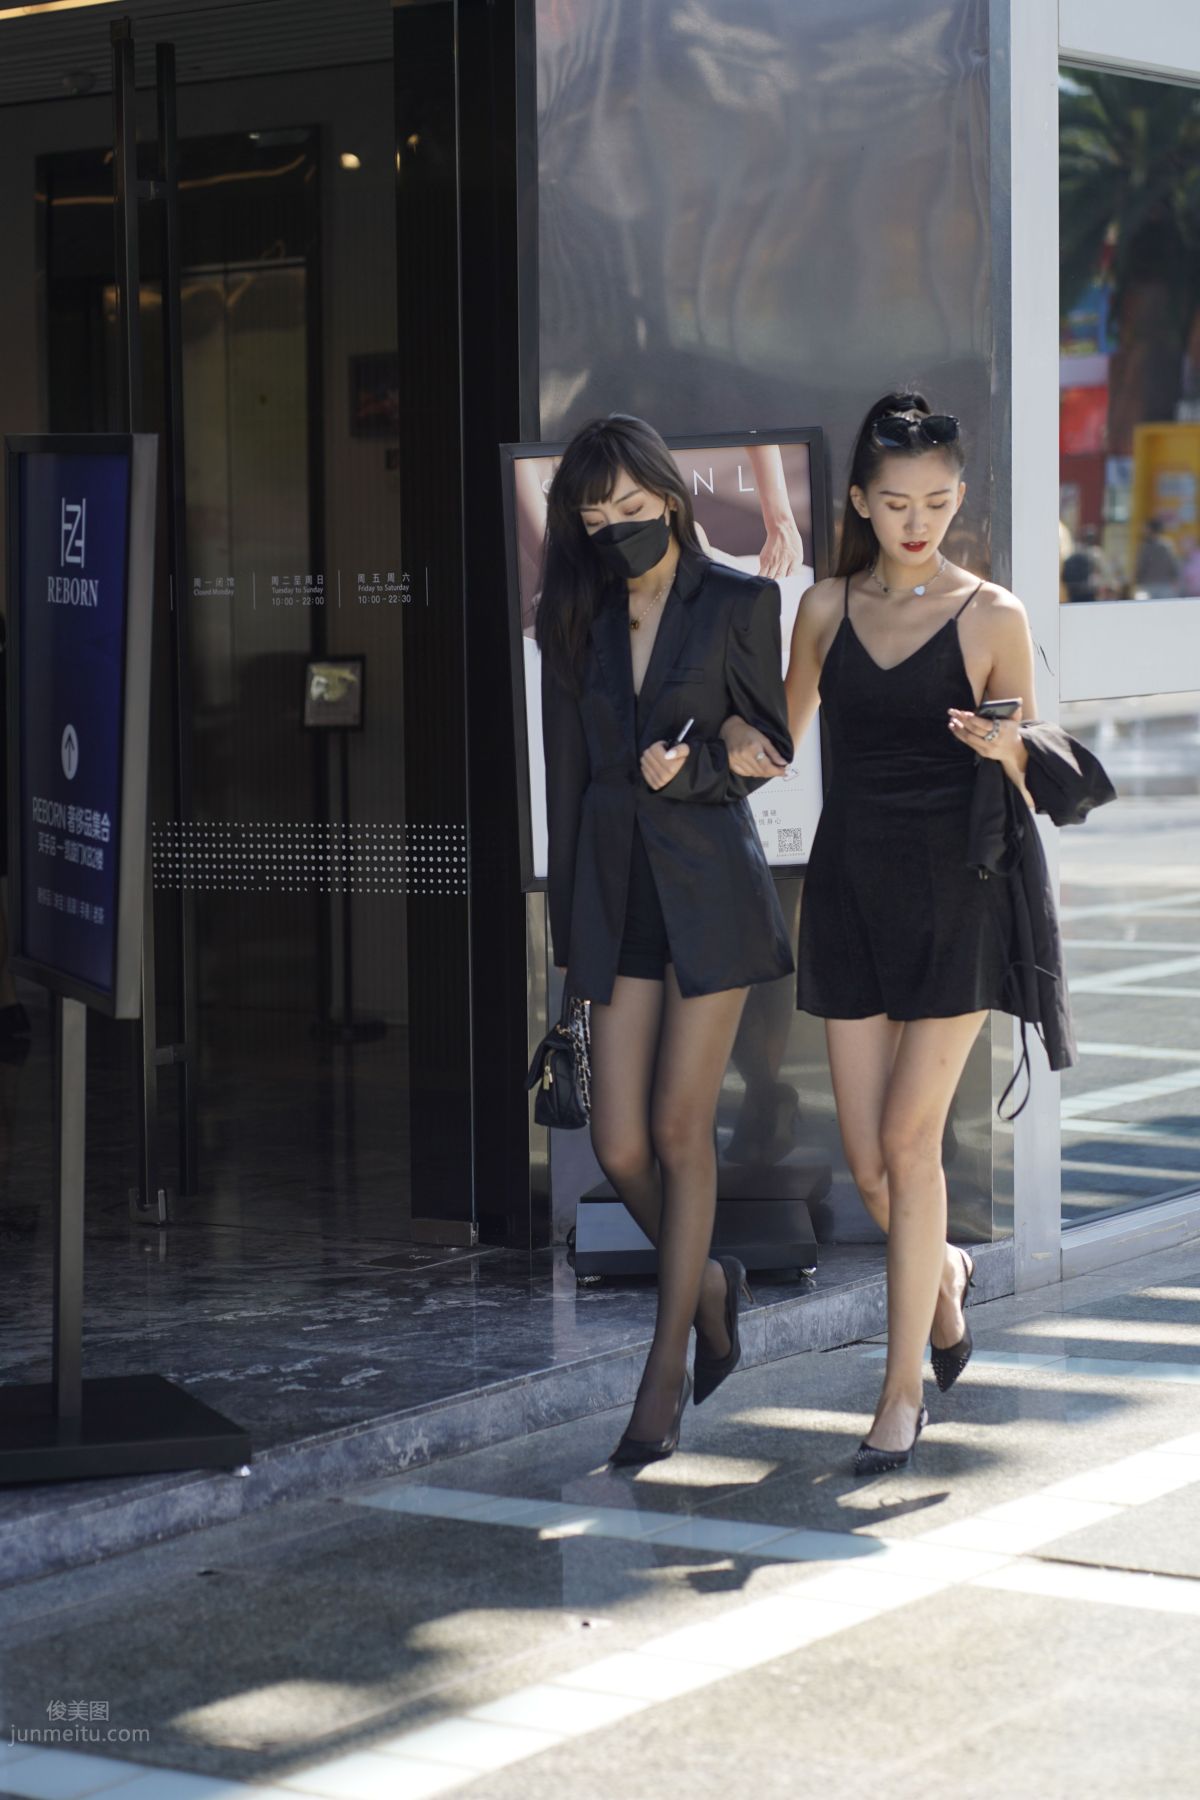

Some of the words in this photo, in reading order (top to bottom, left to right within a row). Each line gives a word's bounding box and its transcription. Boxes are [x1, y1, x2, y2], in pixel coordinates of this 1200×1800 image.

[47, 576, 99, 607] REBORN
[271, 597, 294, 607] 10:00
[302, 596, 325, 606] 22:00
[358, 595, 381, 604] 10:00
[388, 594, 412, 604] 22:30
[32, 796, 67, 830] REBORN
